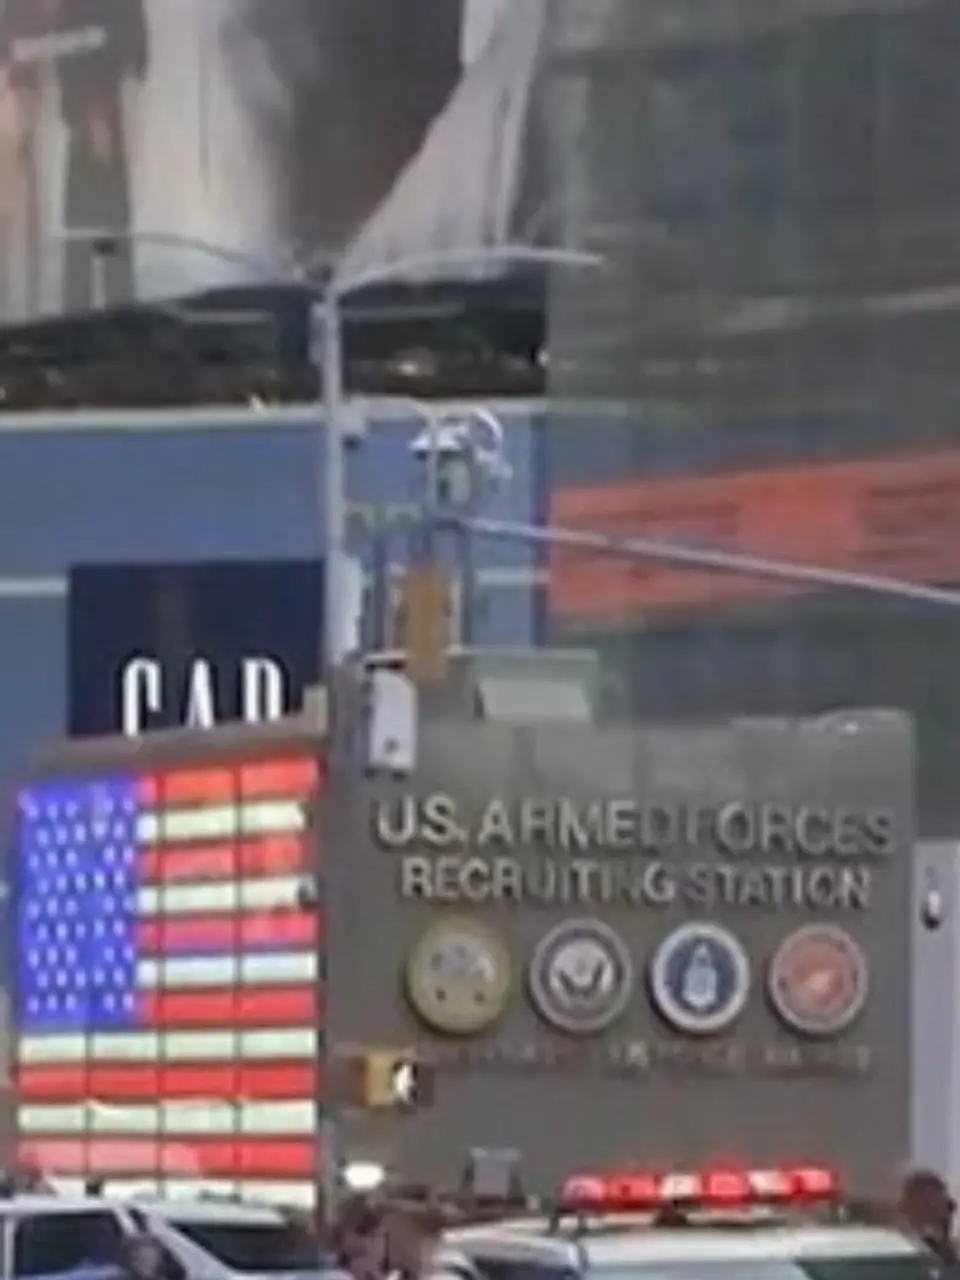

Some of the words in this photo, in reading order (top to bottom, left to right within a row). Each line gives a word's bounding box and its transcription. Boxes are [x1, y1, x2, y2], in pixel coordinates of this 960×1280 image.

[477, 798, 680, 850] ARMED
[402, 856, 677, 902] RECRUITING
[686, 863, 873, 909] STATION
